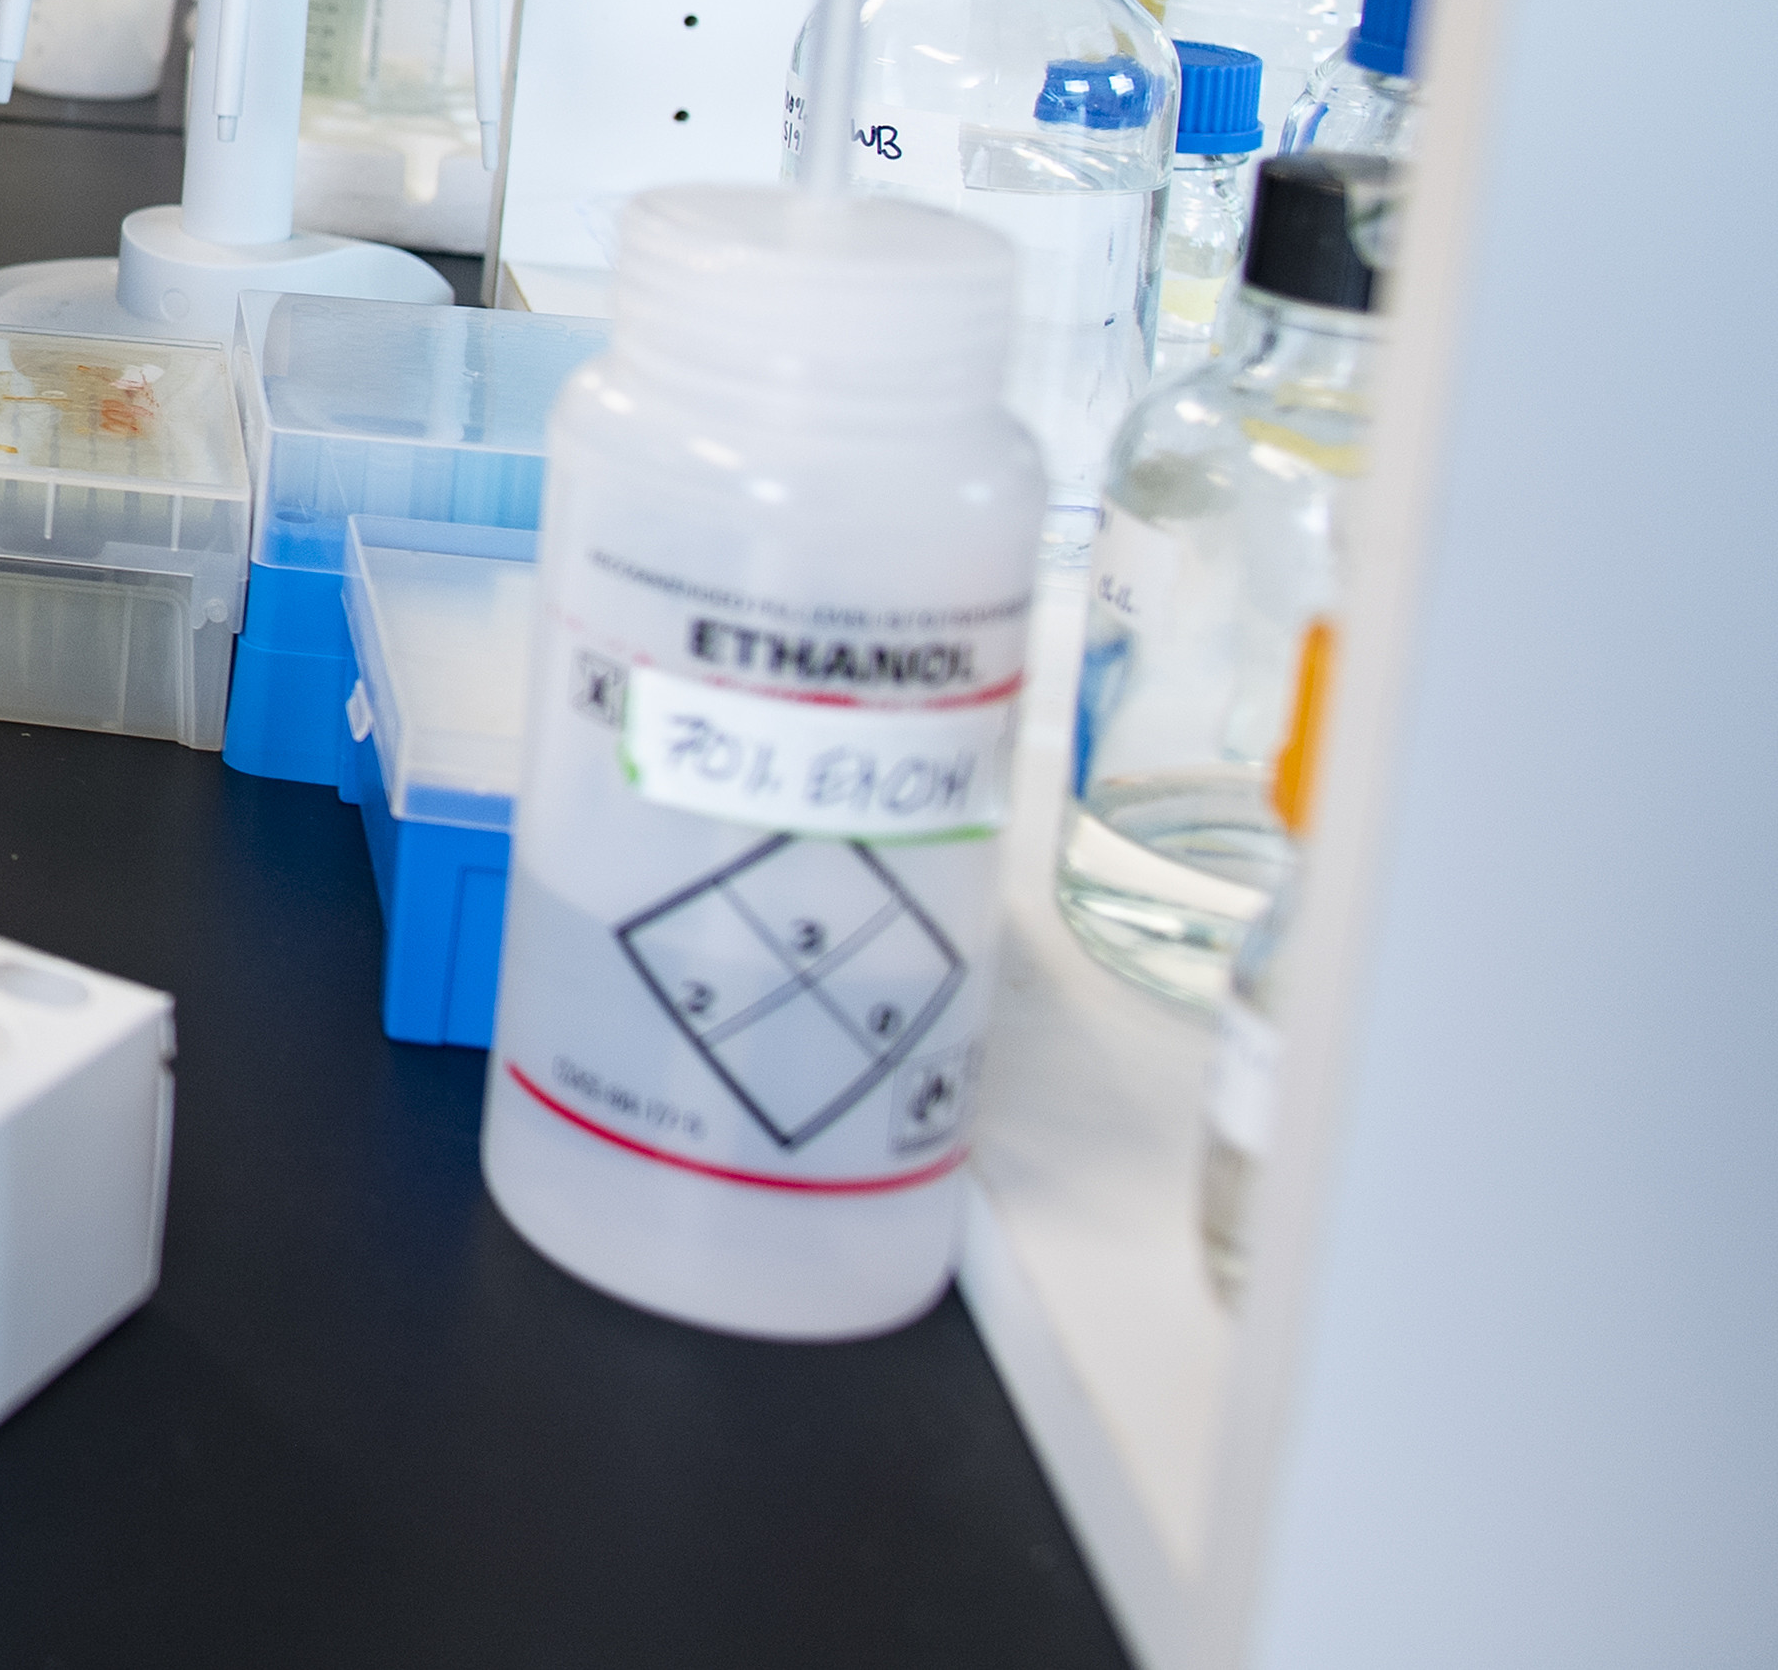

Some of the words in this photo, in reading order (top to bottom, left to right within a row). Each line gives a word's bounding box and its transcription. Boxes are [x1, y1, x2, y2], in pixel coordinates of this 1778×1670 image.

[689, 615, 977, 684] ETHANOL
[792, 918, 827, 955] 3
[684, 980, 717, 1015] 2
